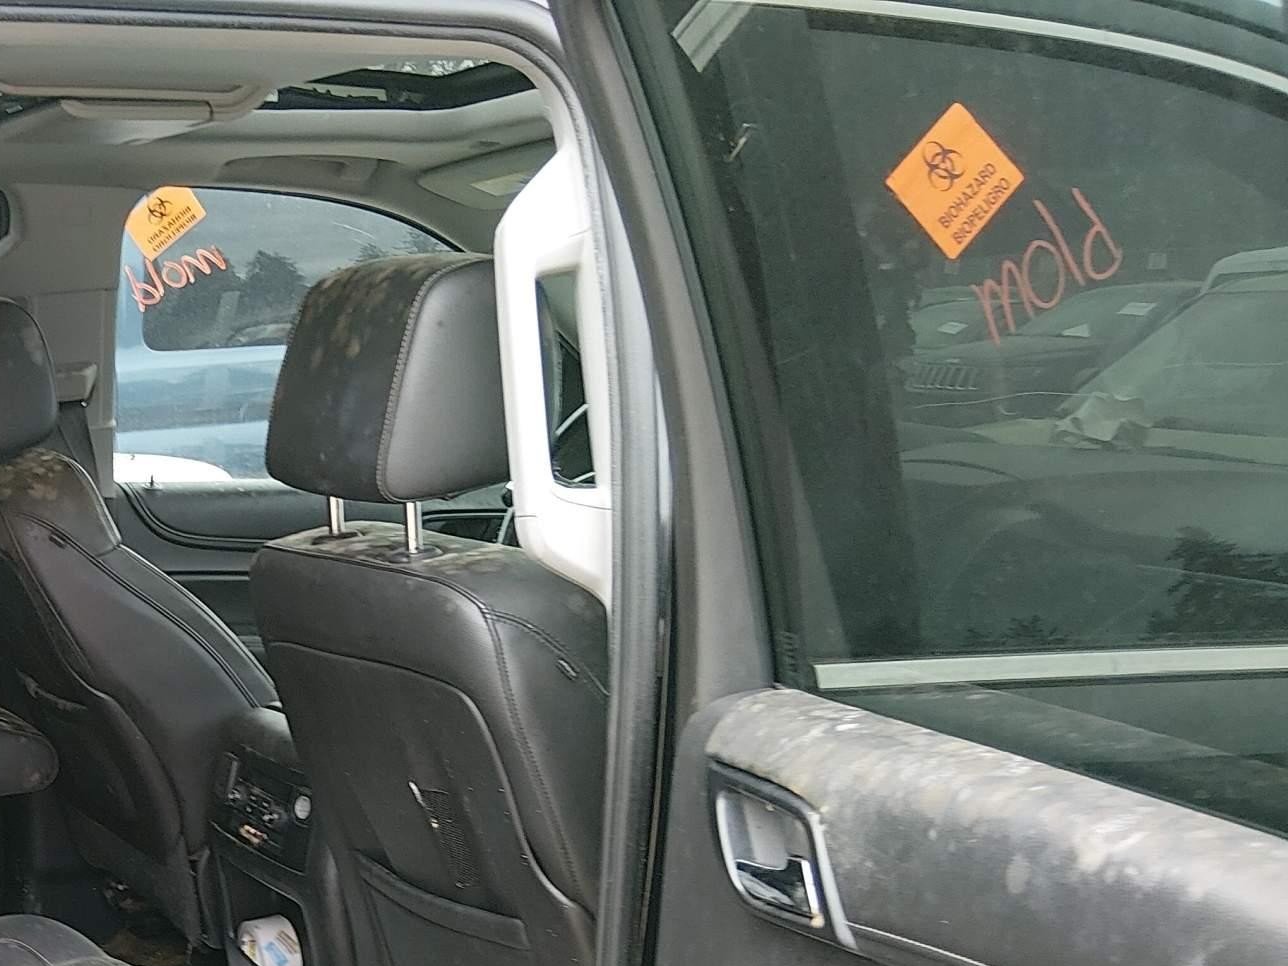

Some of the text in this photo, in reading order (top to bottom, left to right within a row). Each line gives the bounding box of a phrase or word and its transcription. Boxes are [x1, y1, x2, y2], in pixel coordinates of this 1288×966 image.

[938, 162, 996, 229] BIOHAZARD
[952, 177, 1010, 244] BIOPELIGRO
[971, 186, 1123, 346] mold
